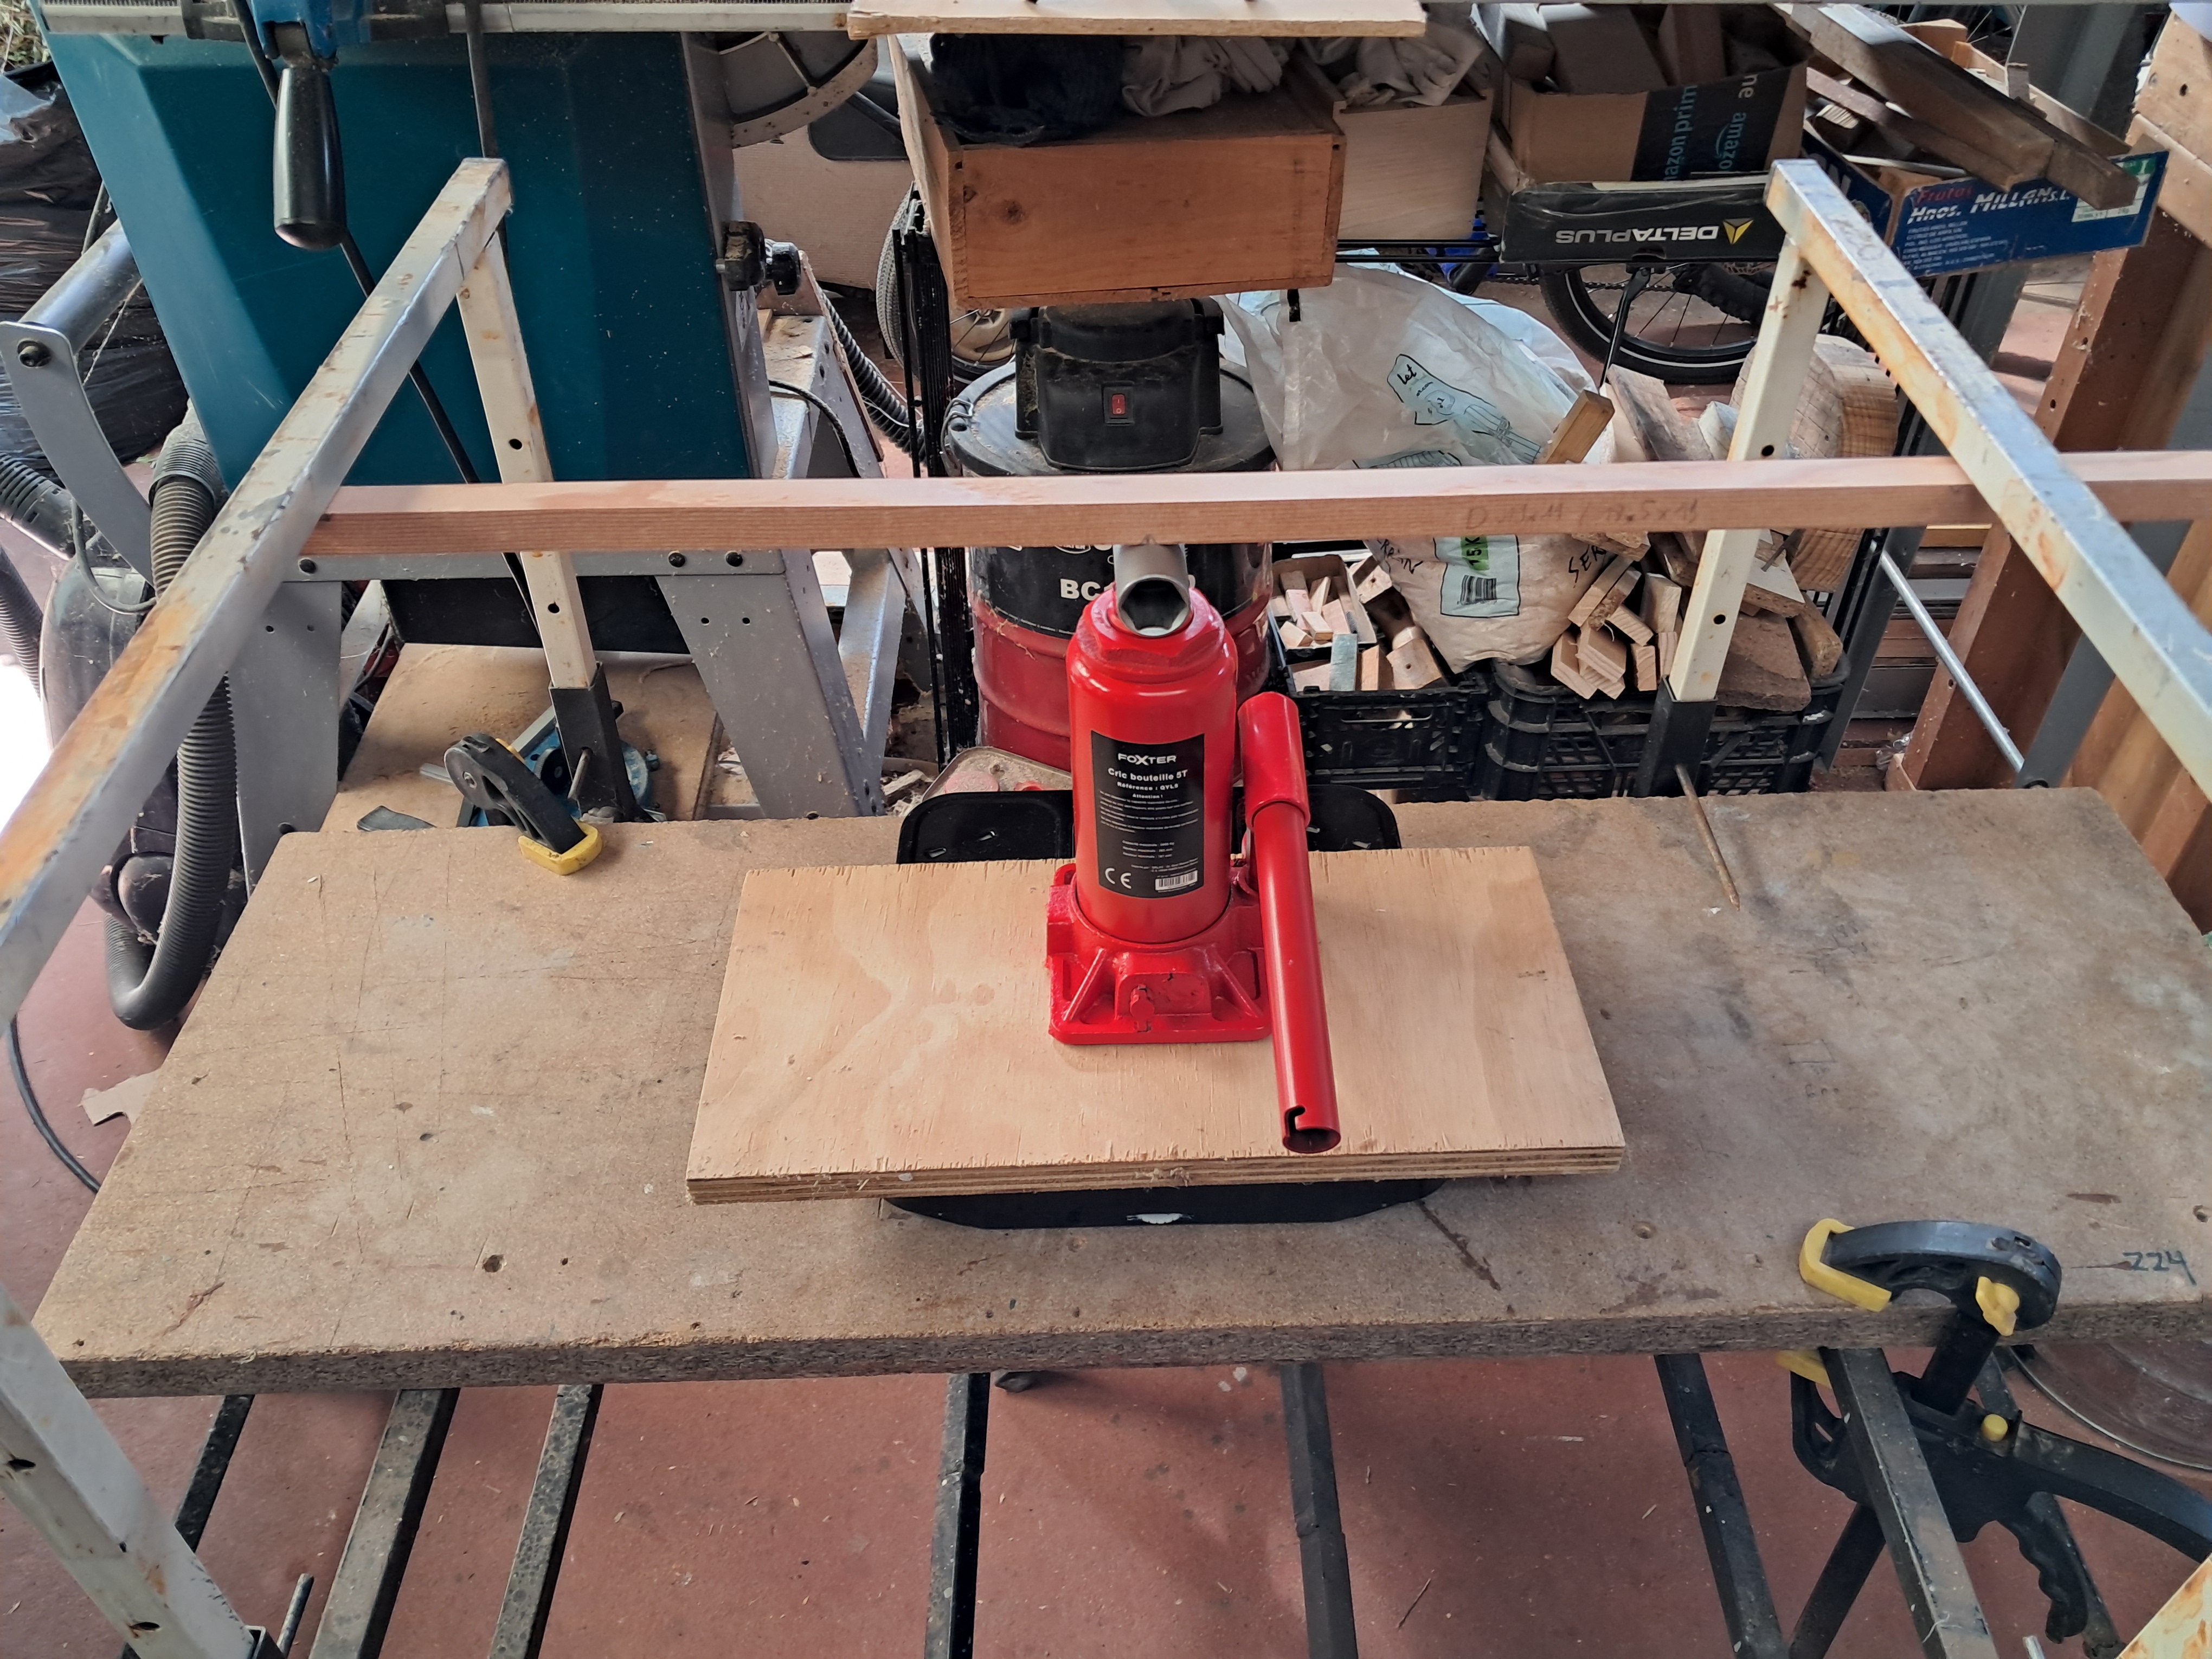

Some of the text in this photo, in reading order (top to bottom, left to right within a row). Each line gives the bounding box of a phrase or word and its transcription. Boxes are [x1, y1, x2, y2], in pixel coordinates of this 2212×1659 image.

[1555, 226, 1720, 243] DELTAPLUS
[1117, 753, 1177, 766] FOXTER
[1108, 768, 1128, 779] Cric
[1130, 773, 1174, 782] bouteille
[2123, 1250, 2197, 1286] 224
